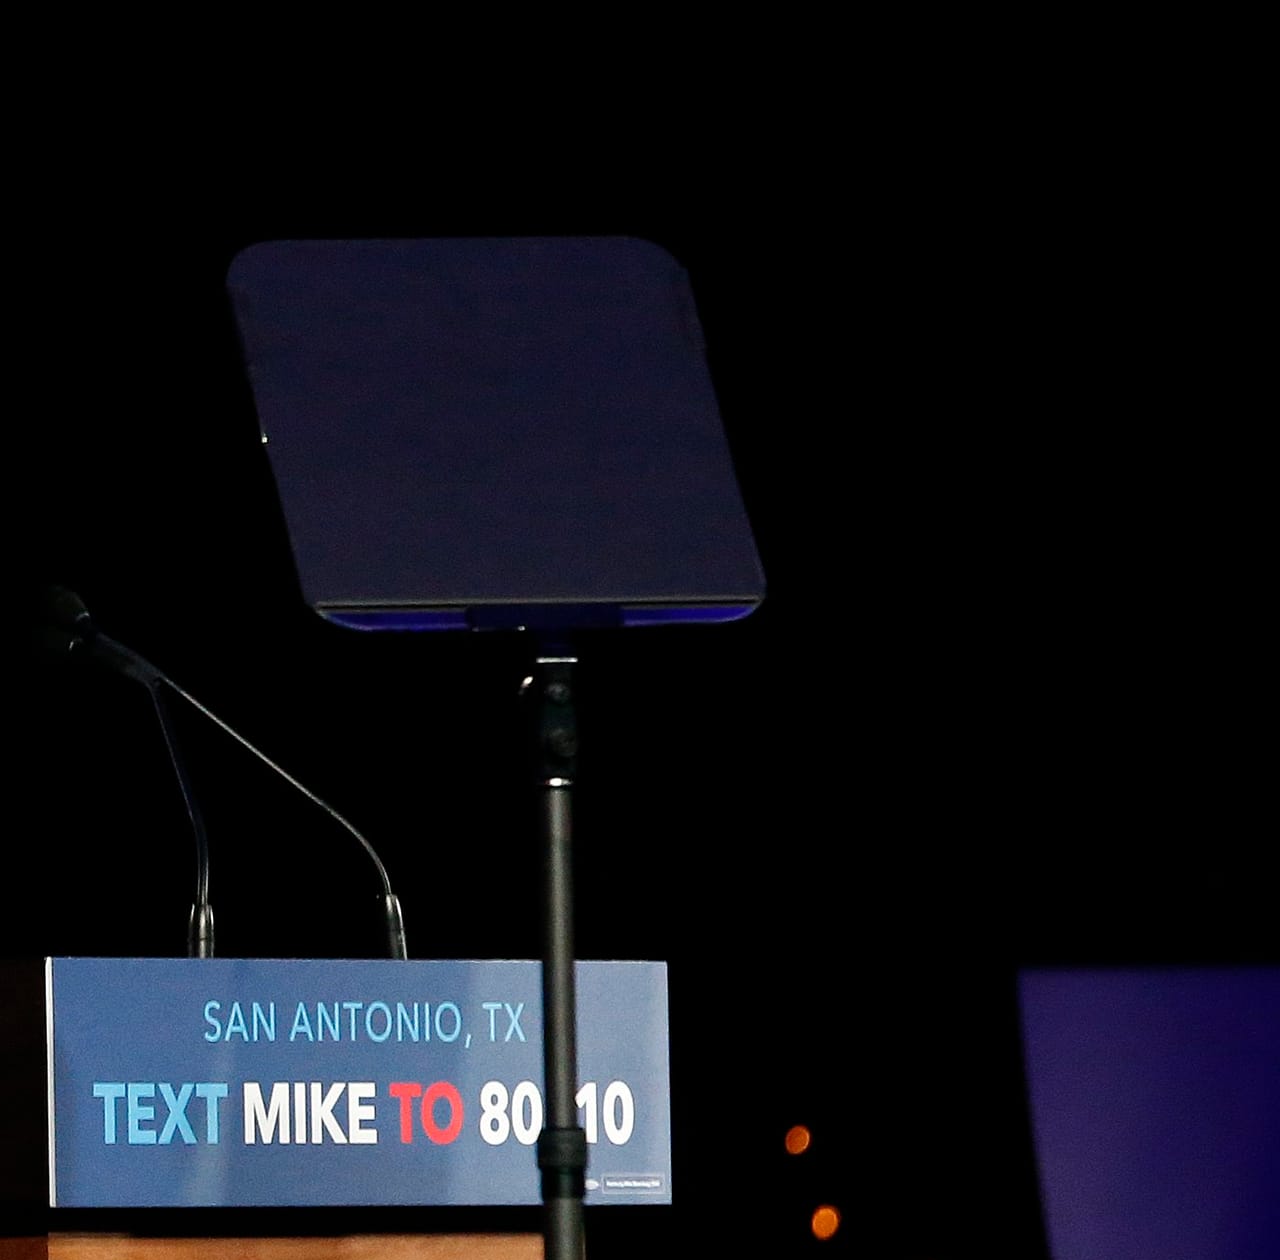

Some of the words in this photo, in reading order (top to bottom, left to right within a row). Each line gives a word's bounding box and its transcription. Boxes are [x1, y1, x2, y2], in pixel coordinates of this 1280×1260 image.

[203, 1000, 276, 1043] SAN
[289, 1000, 472, 1049] ANTONIO,
[482, 1001, 526, 1043] TX
[92, 1081, 229, 1145] TEXT
[242, 1081, 378, 1146] MIKE
[389, 1080, 465, 1145] TO
[478, 1080, 636, 1146] 8010
